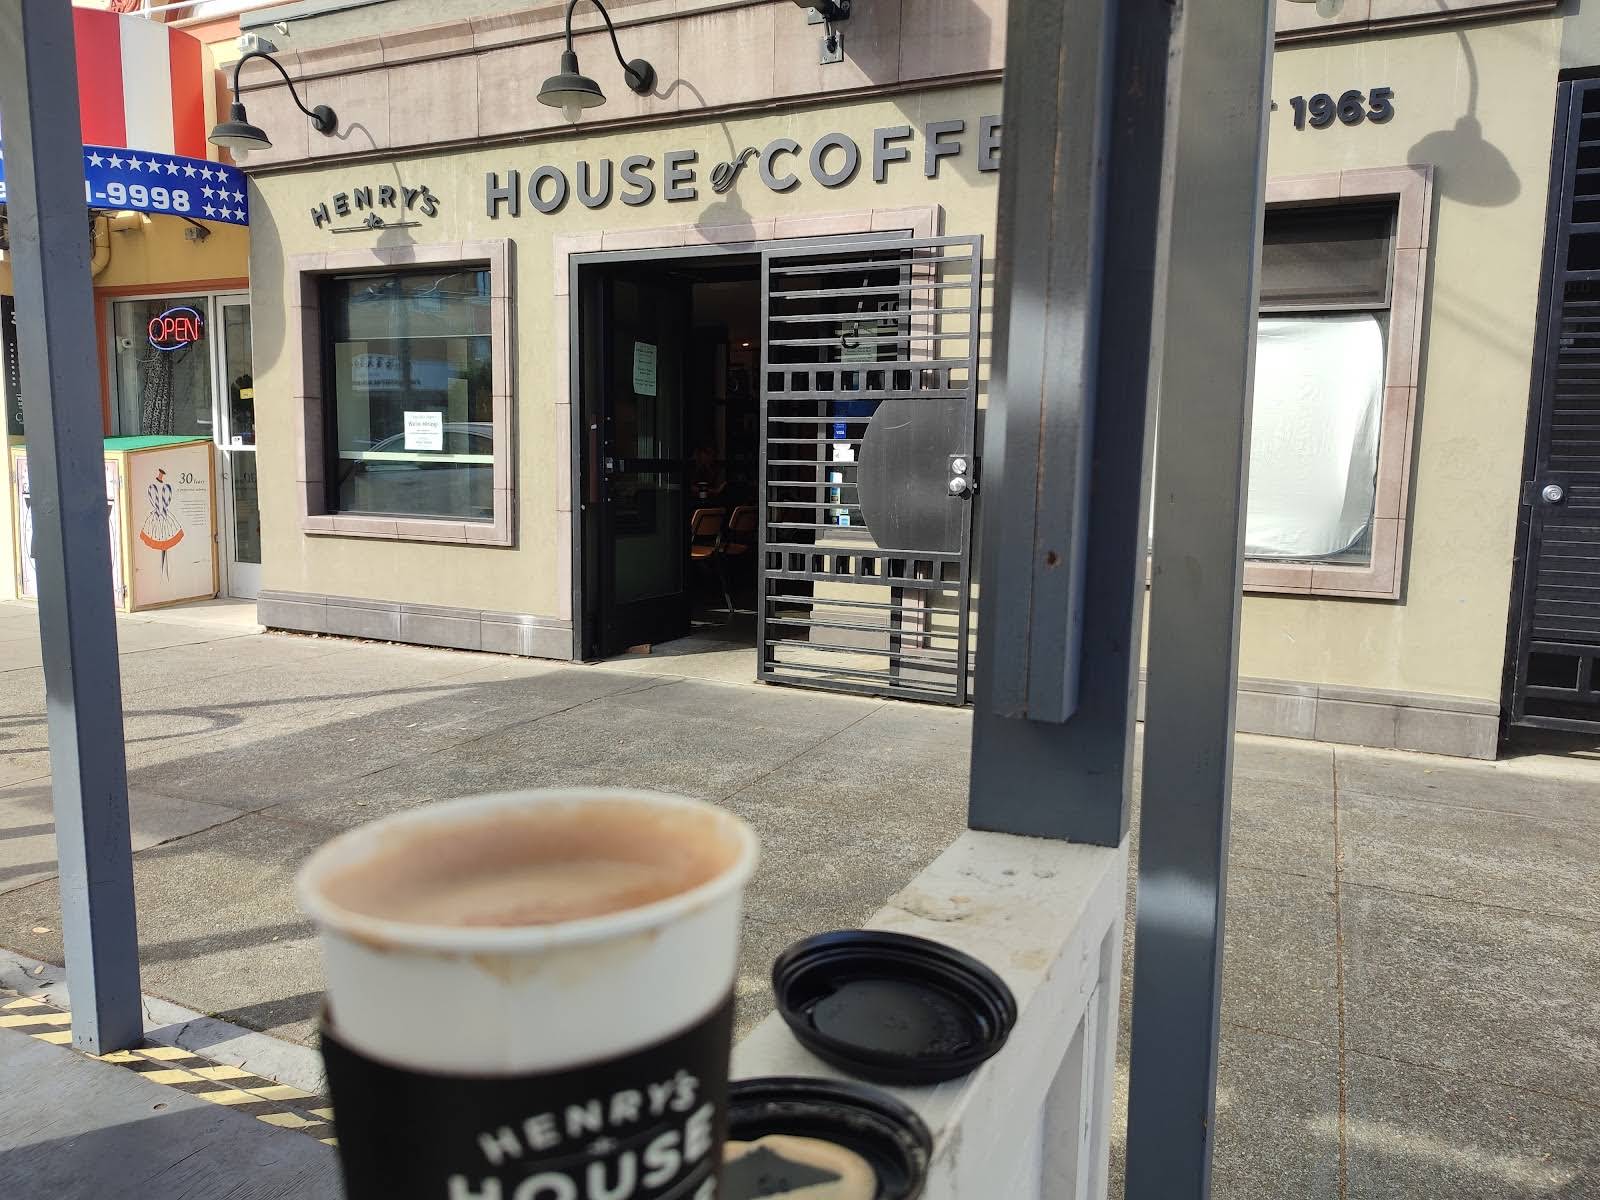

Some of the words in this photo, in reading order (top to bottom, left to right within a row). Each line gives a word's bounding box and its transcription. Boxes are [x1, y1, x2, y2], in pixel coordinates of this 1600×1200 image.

[1289, 87, 1394, 130] 1965
[486, 149, 698, 217] HOUSE
[709, 146, 761, 193] of
[310, 185, 440, 228] HENRY'S
[148, 317, 199, 342] OPEN
[179, 472, 193, 484] 30
[476, 1069, 699, 1166] HENRY'S
